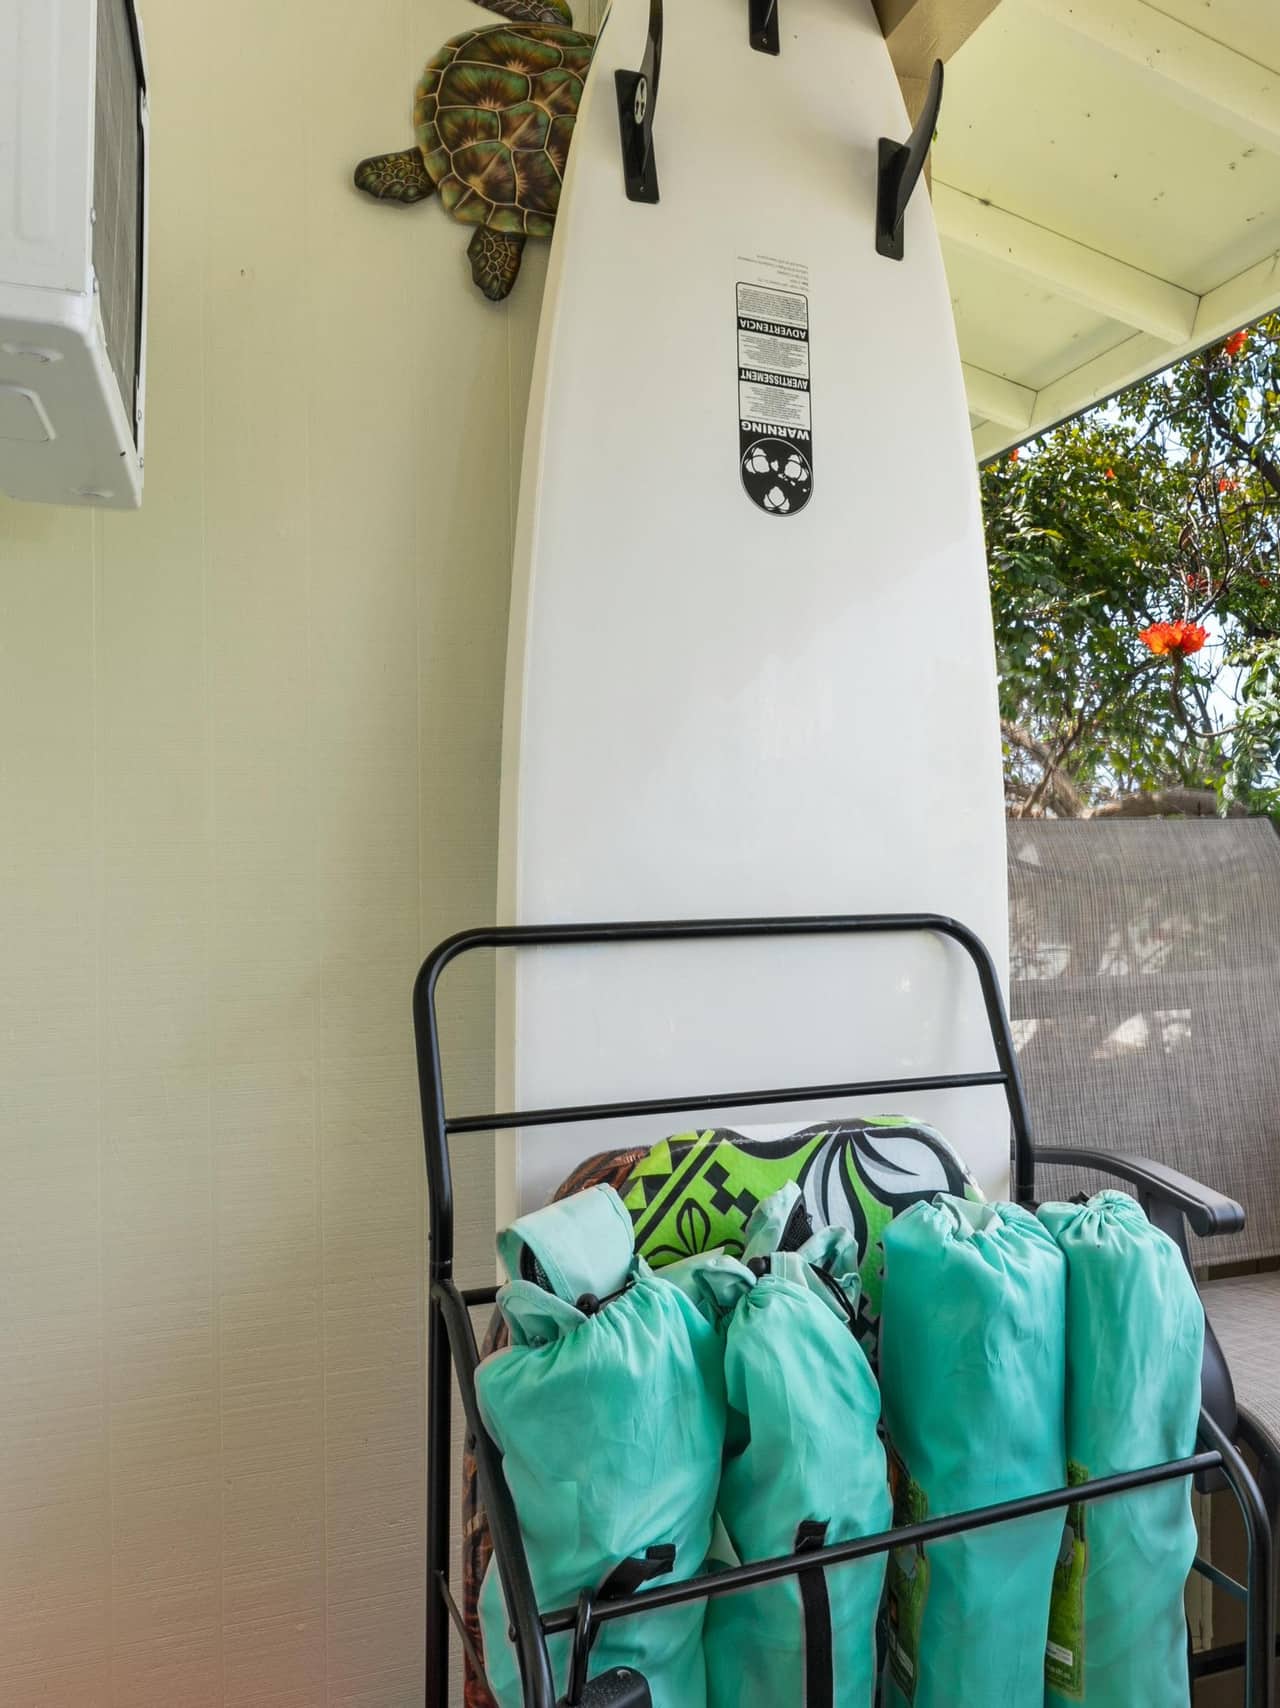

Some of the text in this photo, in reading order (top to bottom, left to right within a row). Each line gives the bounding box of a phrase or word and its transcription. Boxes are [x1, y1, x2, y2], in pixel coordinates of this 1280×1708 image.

[740, 318, 807, 339] ADVERTENCIA
[740, 369, 808, 390] AVERTISSEMENT
[741, 420, 810, 441] WARNING
